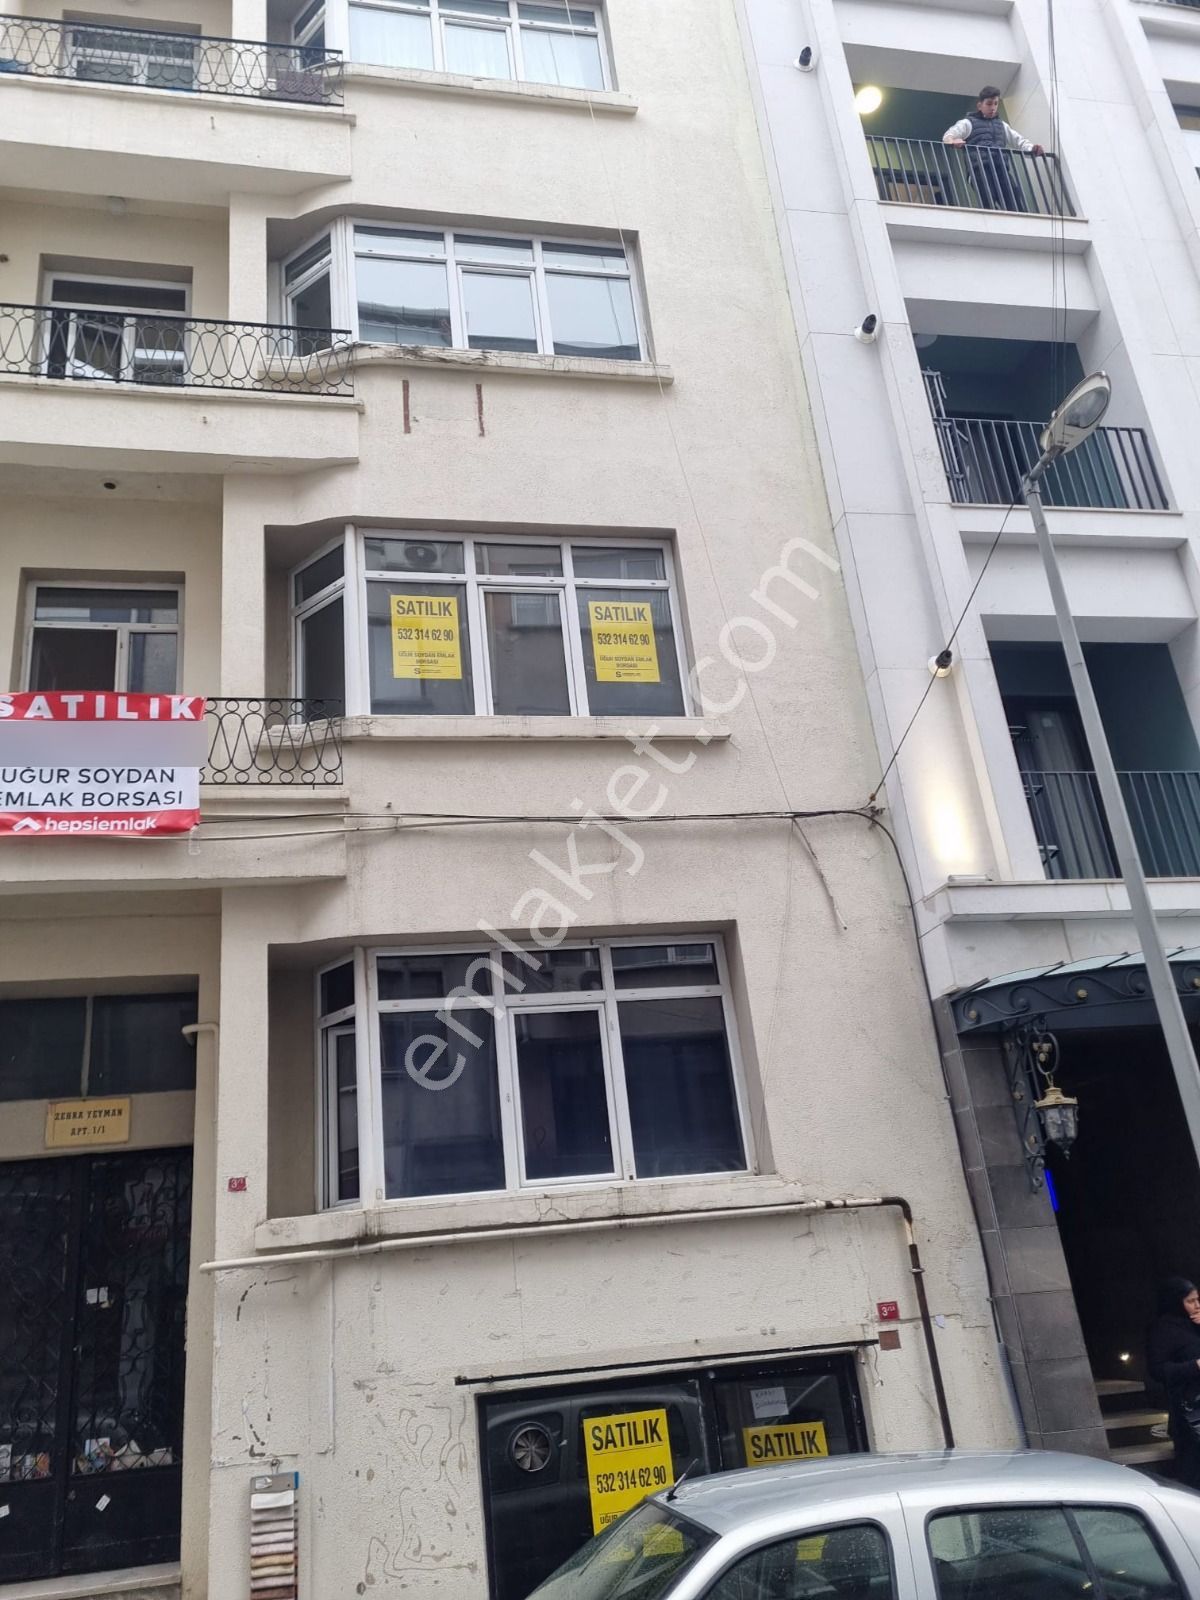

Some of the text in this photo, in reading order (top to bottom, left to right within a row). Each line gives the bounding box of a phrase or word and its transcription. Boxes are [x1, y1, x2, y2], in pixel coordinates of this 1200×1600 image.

[396, 600, 453, 617] SATILIK
[594, 606, 648, 622] SATILIK
[398, 628, 454, 642] 532 314 62 90
[597, 633, 650, 646] 532 314 62 90
[0, 694, 196, 719] SATILIK
[2, 766, 175, 785] UĞUR SOYDAN
[0, 790, 183, 807] MLAK BORSASI
[44, 816, 157, 833] hepsiemlak
[591, 1418, 663, 1451] SATILIK
[751, 1429, 821, 1459] SATILIK
[596, 1465, 667, 1494] 532 314 62 90
